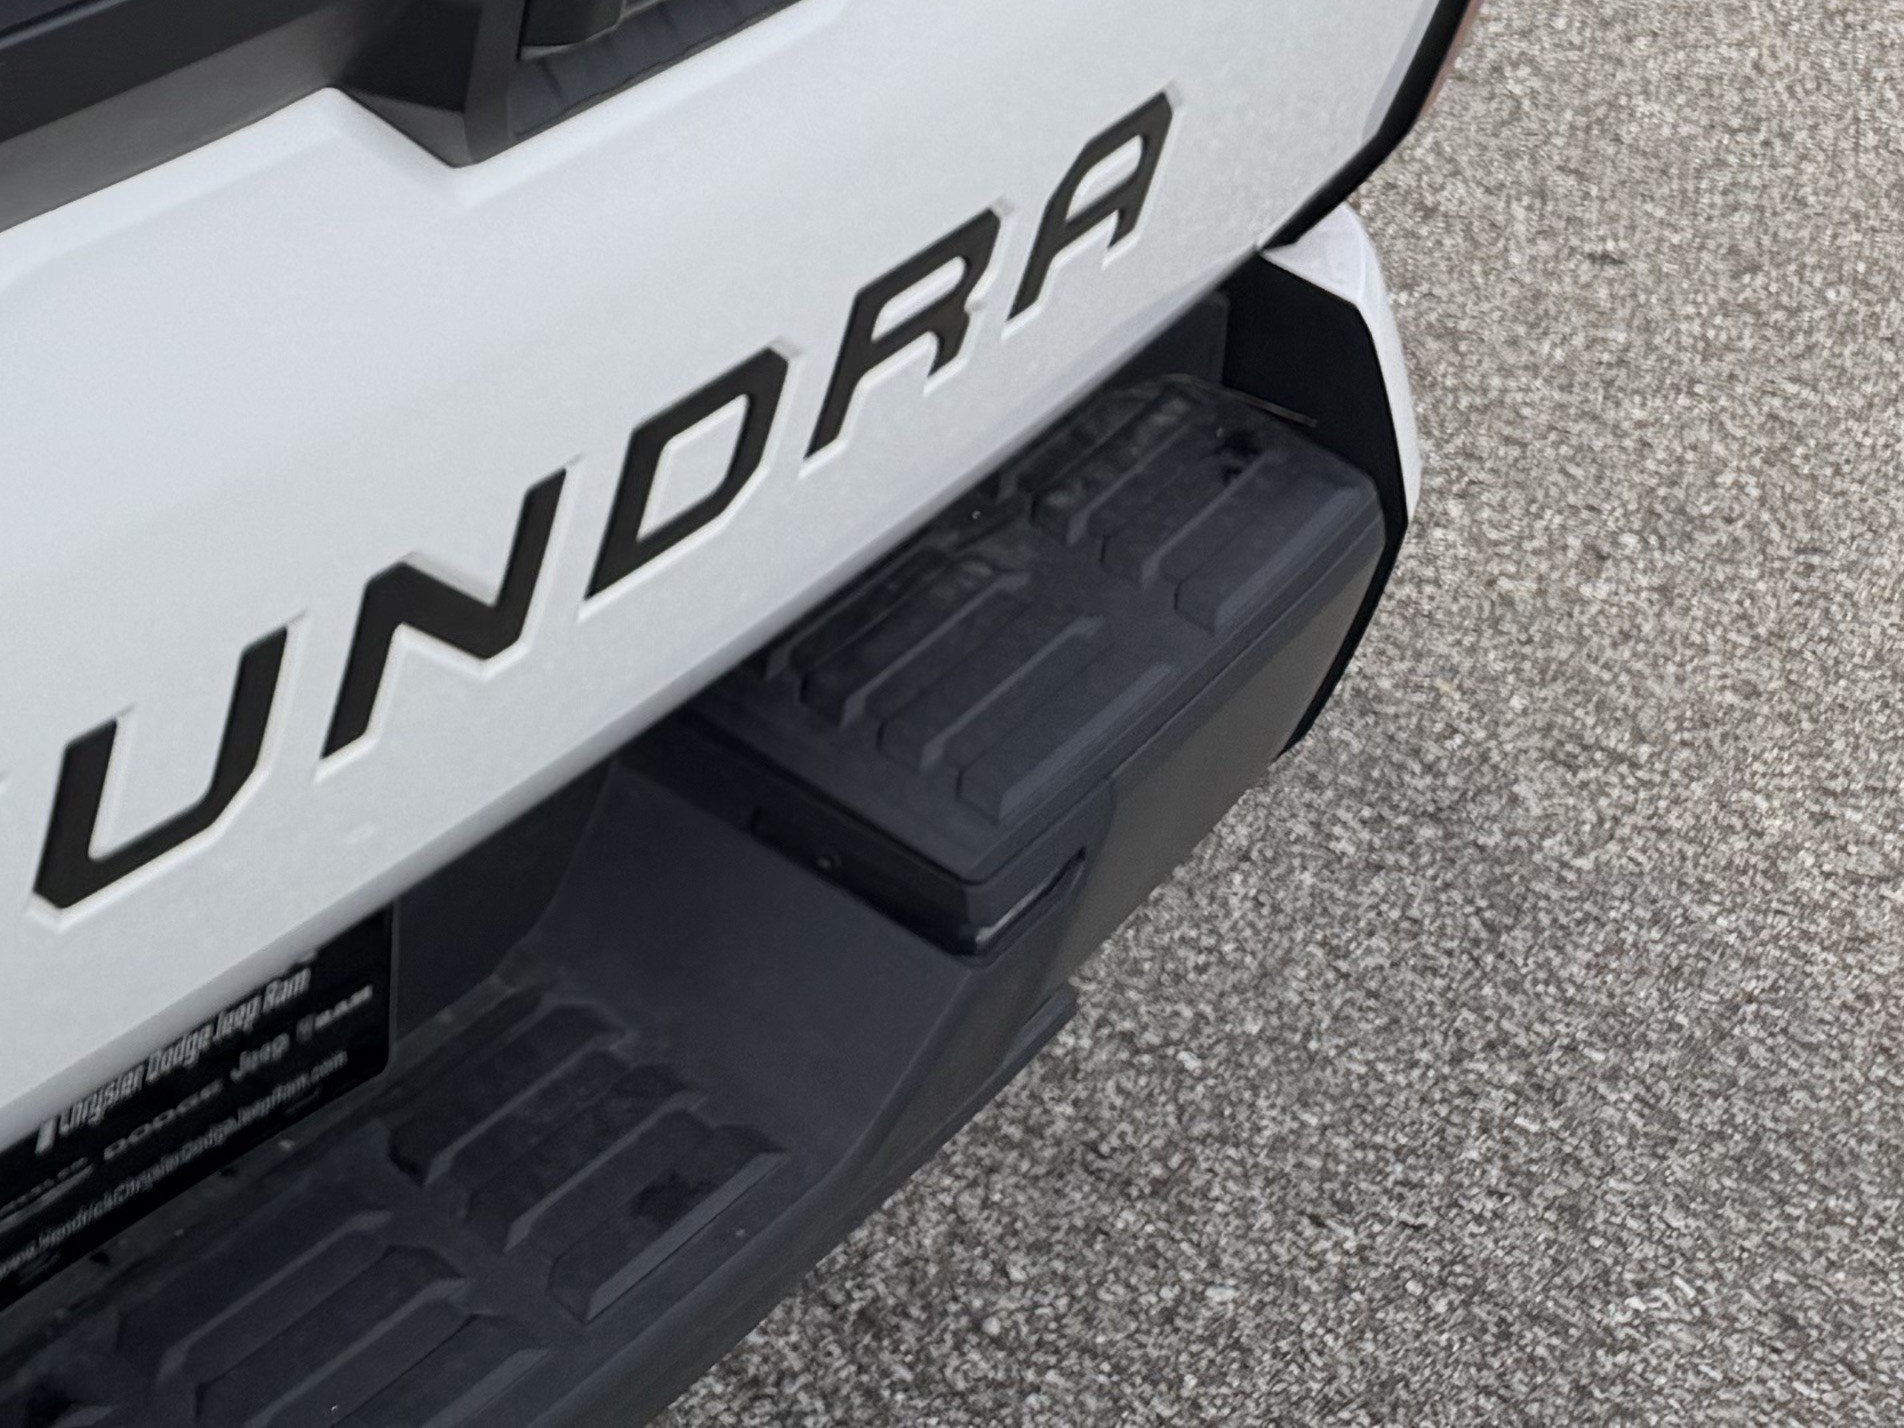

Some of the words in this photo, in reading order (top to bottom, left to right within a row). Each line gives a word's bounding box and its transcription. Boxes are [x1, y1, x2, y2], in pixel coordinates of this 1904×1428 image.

[145, 1023, 214, 1083] Dodge
[213, 995, 262, 1043] Jeep
[262, 966, 312, 1014] Ram
